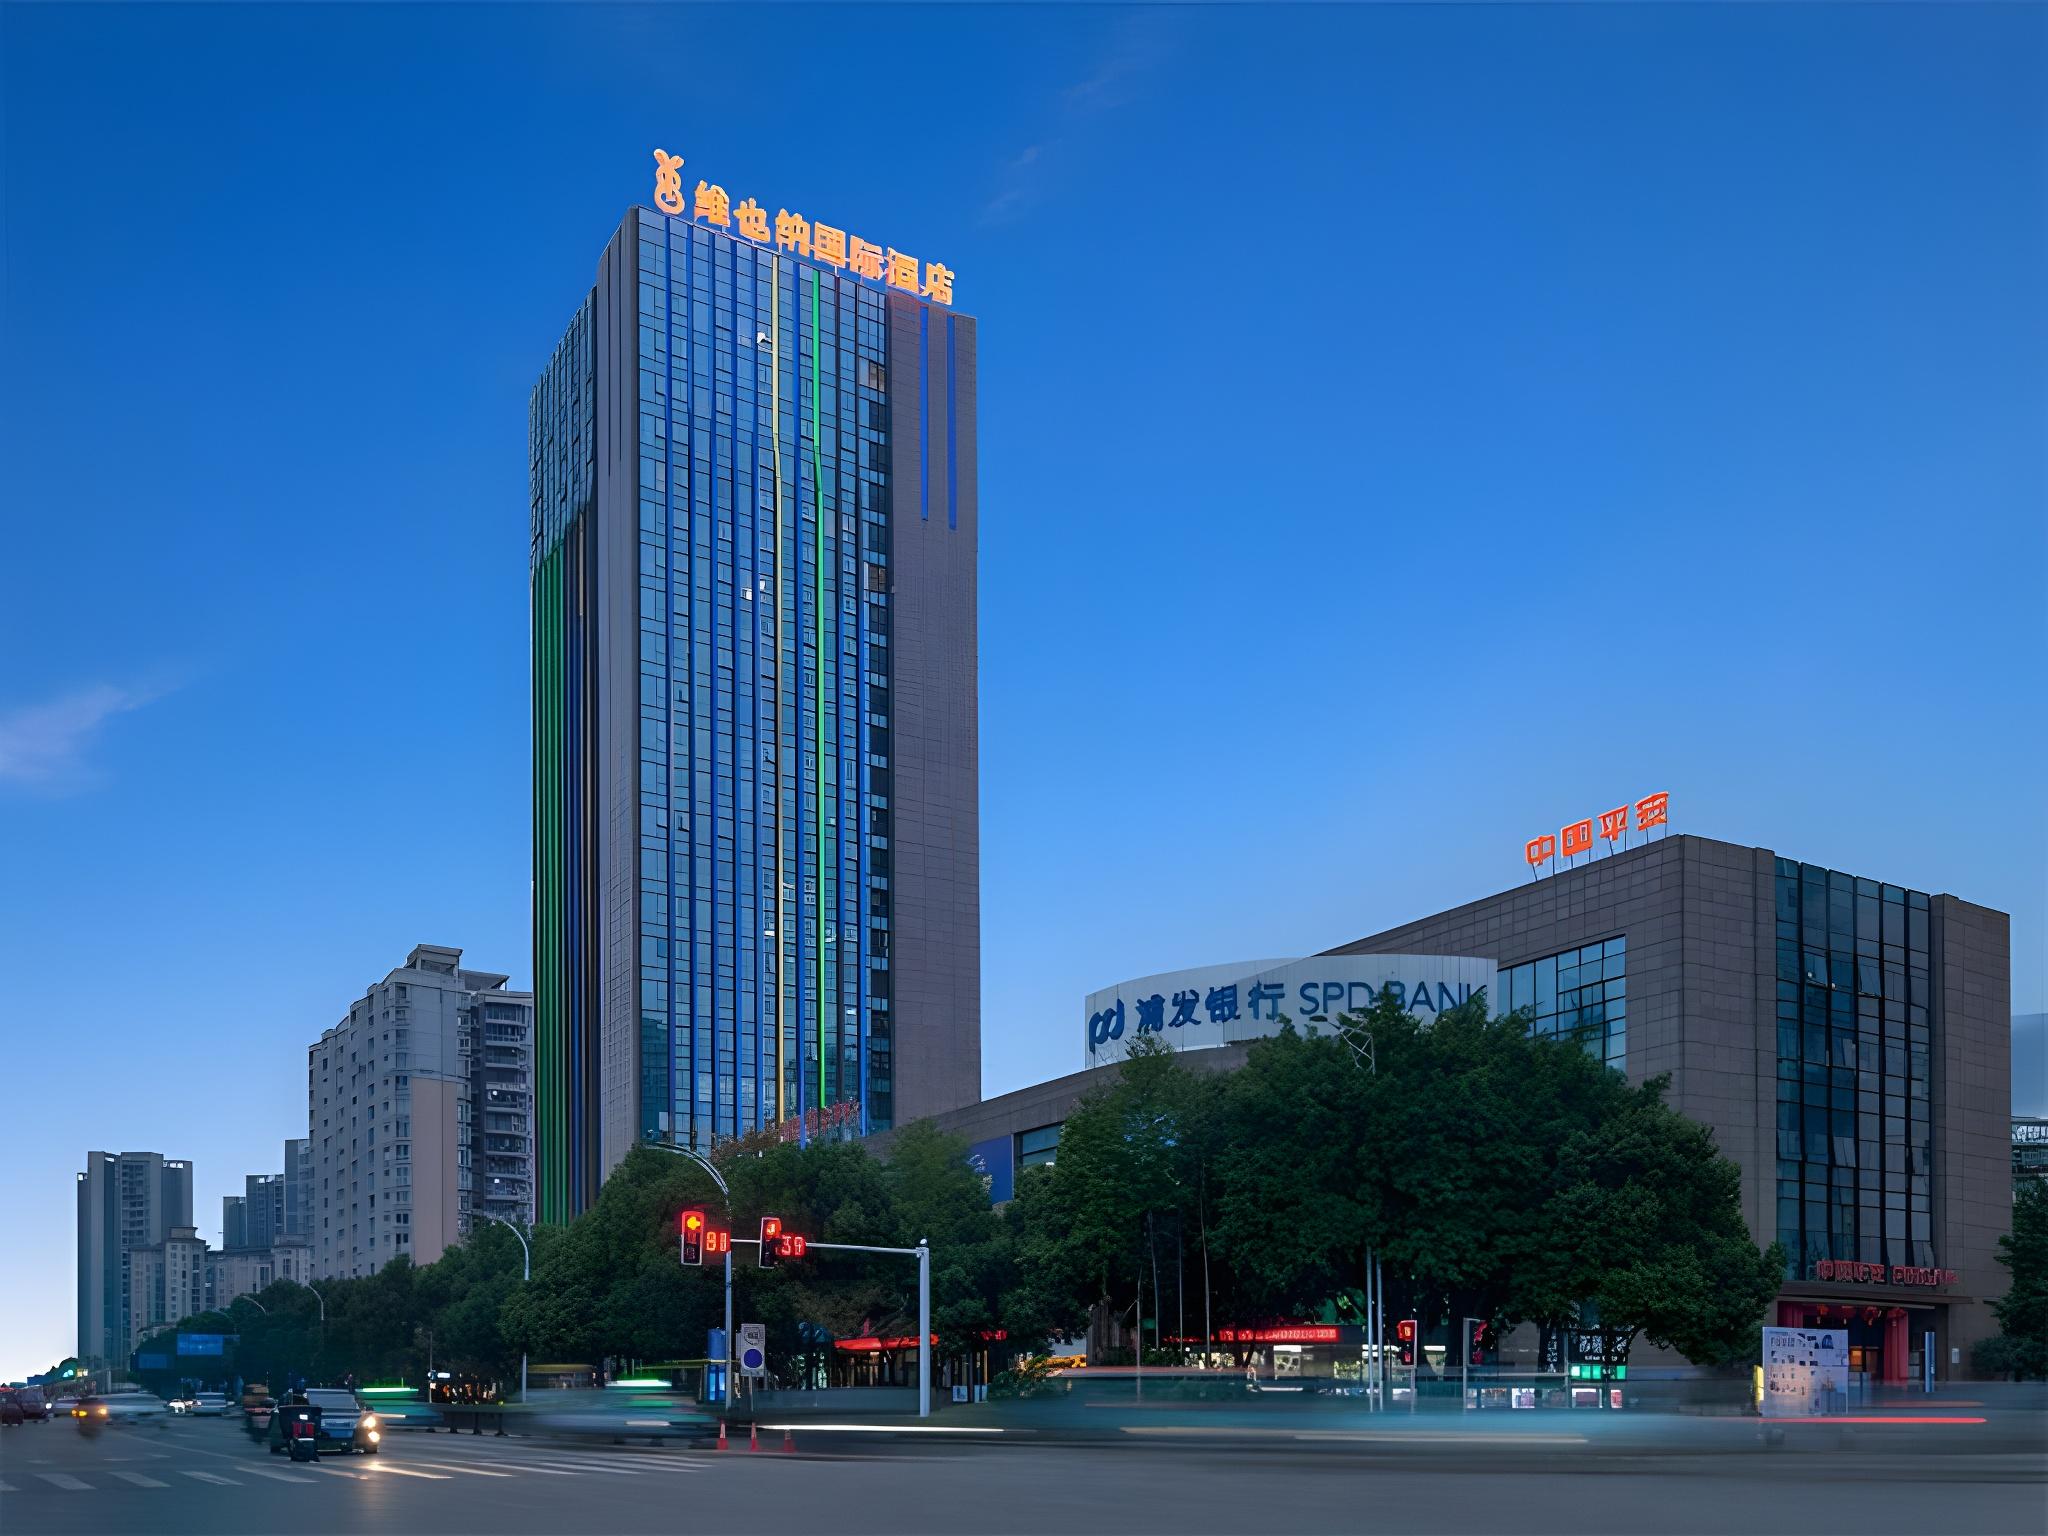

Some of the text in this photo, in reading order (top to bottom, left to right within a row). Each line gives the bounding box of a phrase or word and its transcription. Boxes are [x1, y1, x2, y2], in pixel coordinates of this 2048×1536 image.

[694, 180, 955, 306] 维也纳国际酒店
[1135, 979, 1286, 1034] 浦发银行
[1299, 981, 1375, 1015] SPD
